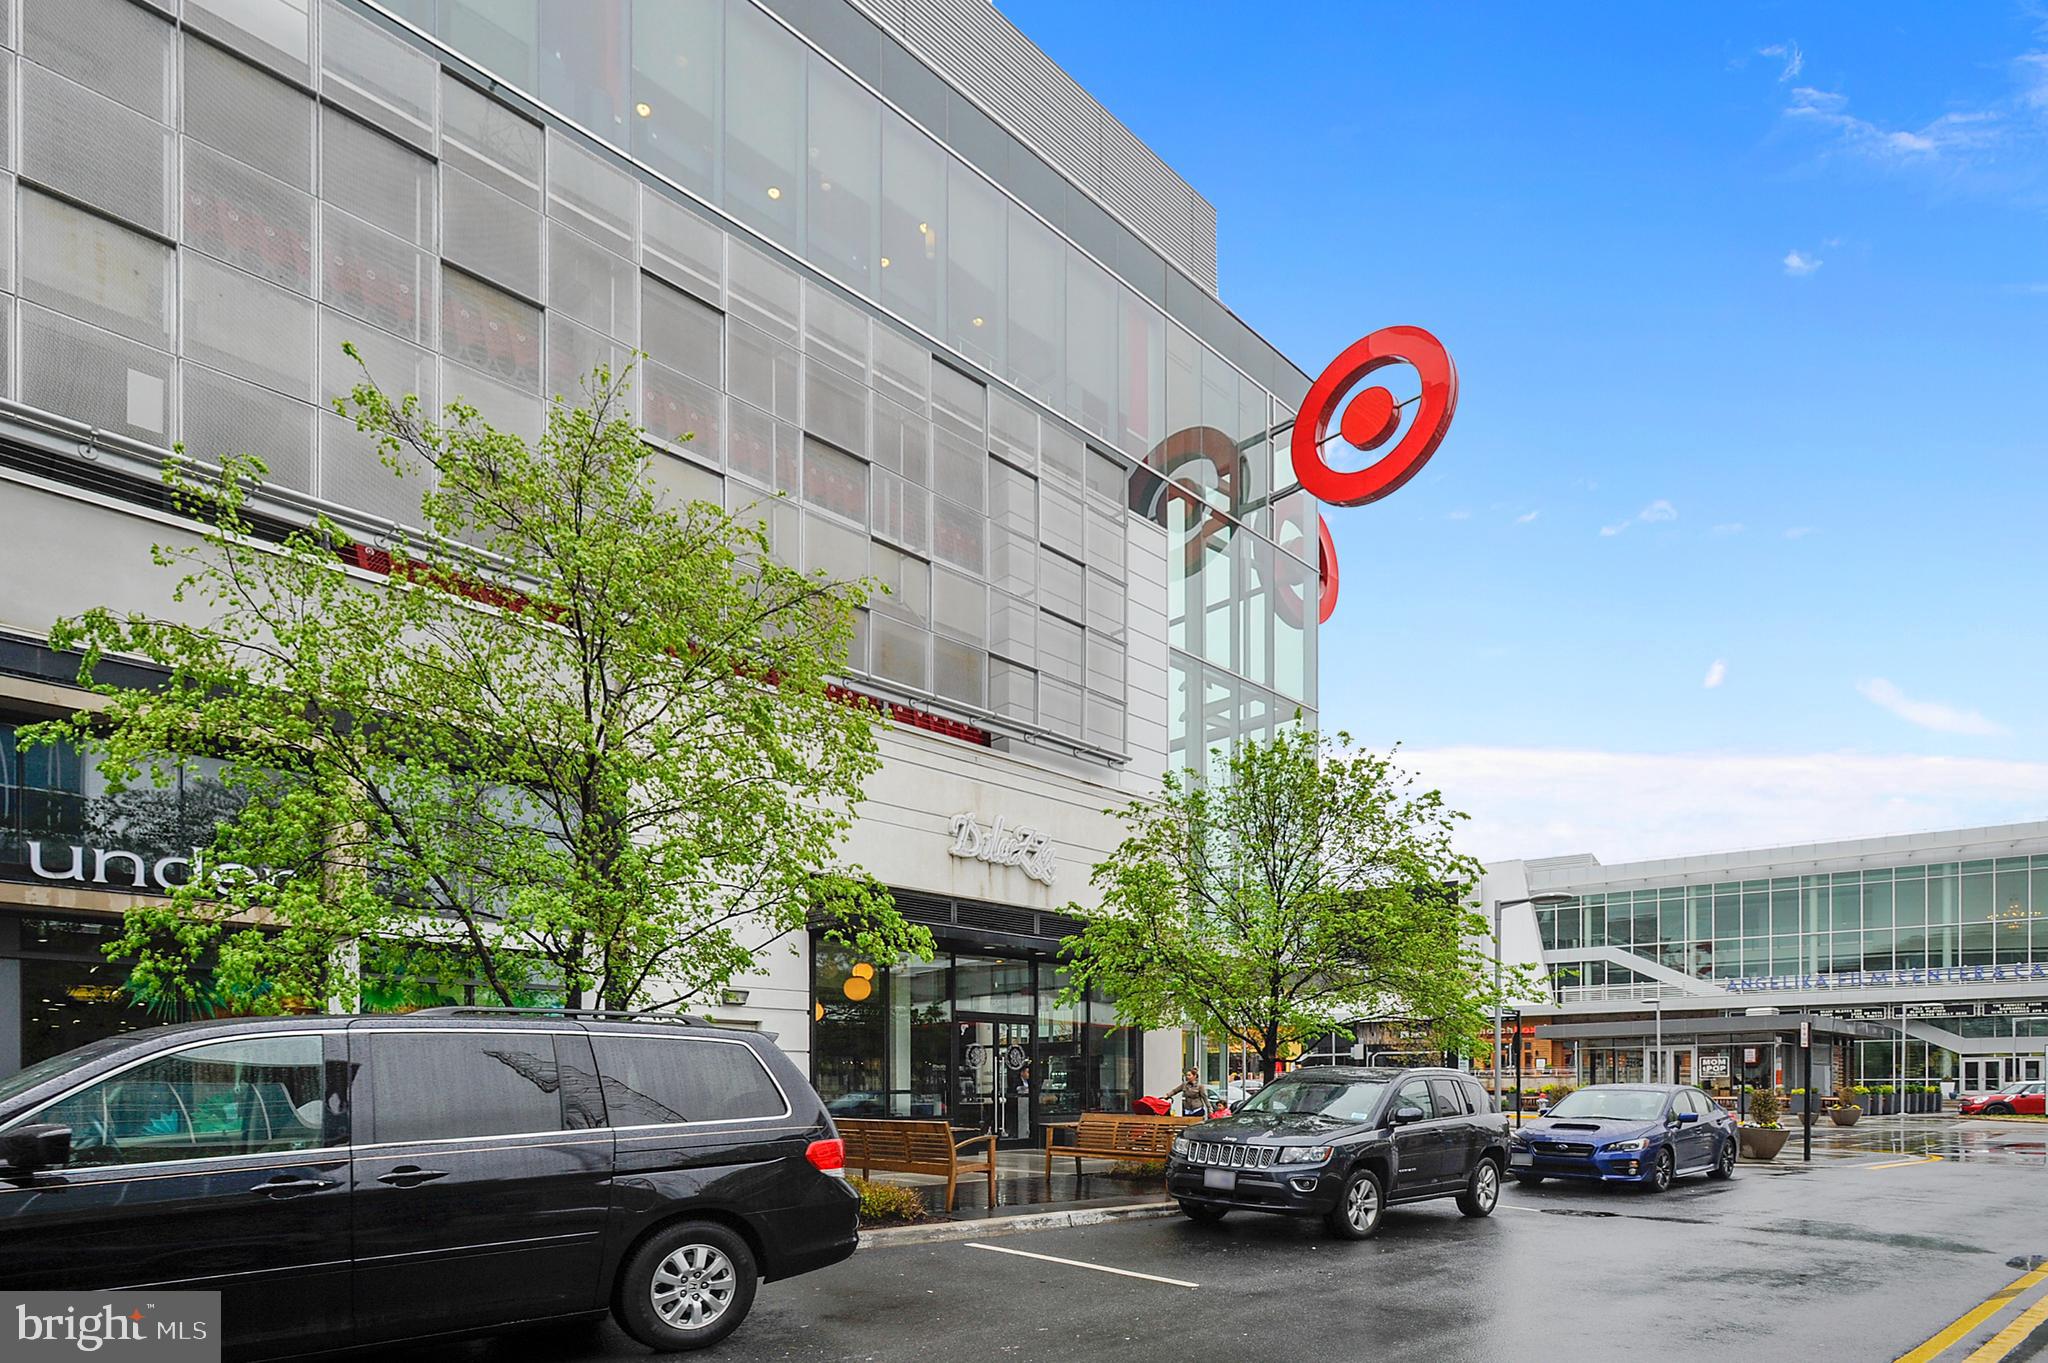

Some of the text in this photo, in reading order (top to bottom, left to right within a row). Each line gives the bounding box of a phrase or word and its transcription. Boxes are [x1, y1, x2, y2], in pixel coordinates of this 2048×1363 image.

[1727, 974, 1828, 992] ANGELIKA
[1839, 972, 1888, 987] FILM
[1899, 965, 1985, 983] CENTER
